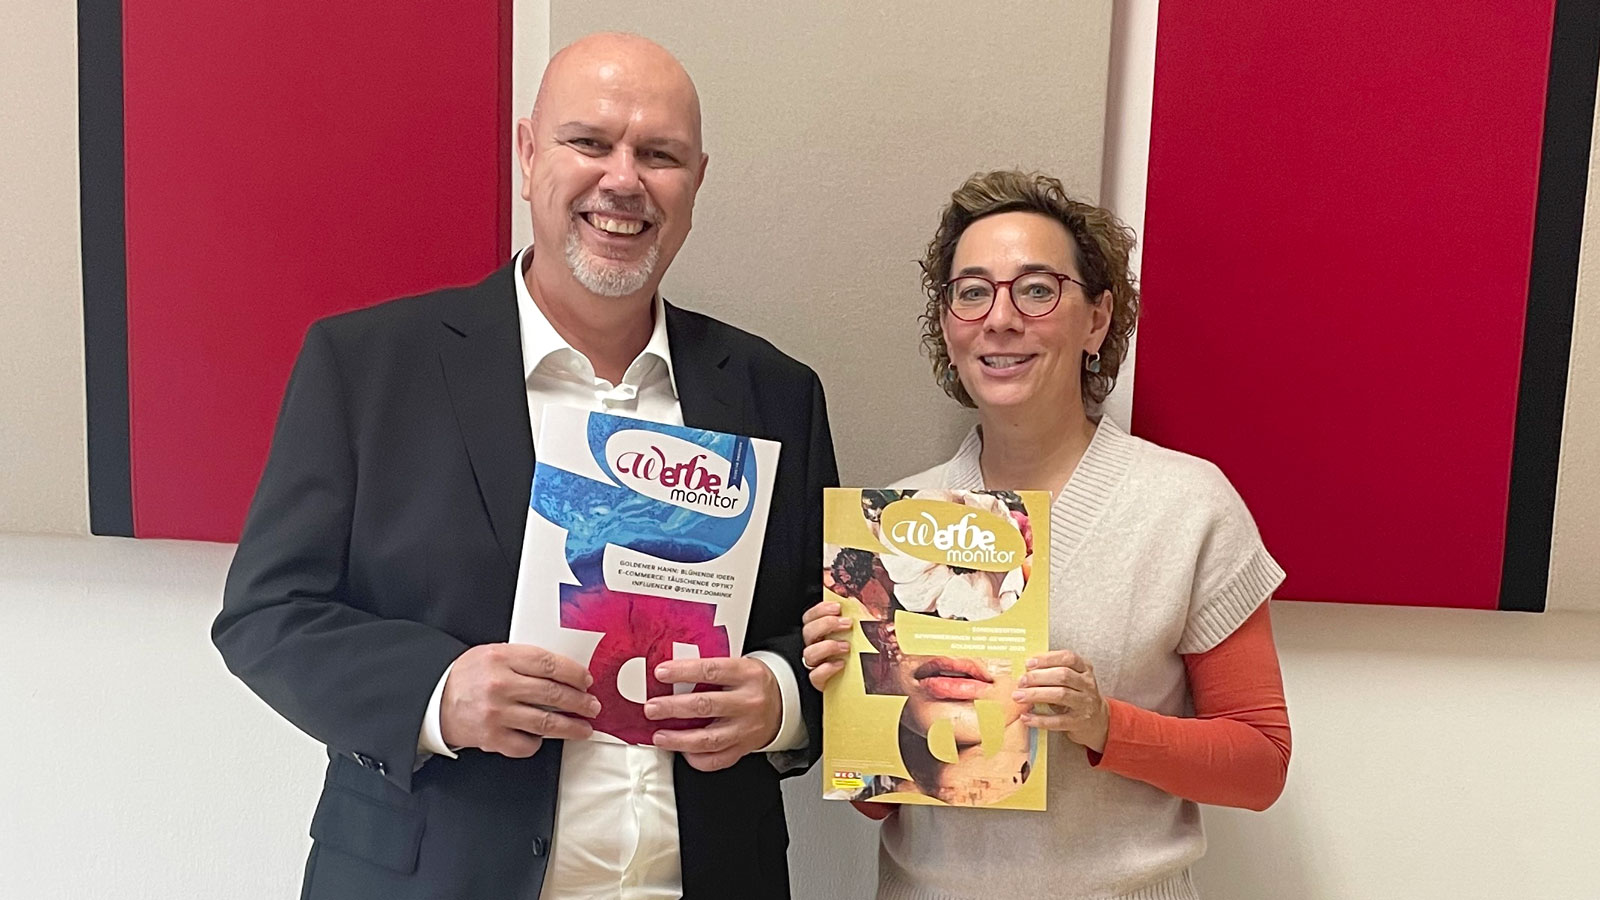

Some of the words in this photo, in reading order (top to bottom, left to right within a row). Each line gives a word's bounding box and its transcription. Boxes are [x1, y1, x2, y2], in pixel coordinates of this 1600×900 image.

[616, 445, 721, 494] Werbe
[670, 488, 738, 509] monitor
[891, 511, 995, 550] Werbe
[946, 548, 1015, 563] monitor
[618, 569, 666, 581] E-COMMERCE:
[667, 576, 709, 587] TÄUSCHENDE
[711, 582, 734, 590] OPTIK?
[619, 560, 656, 571] GOLDENER
[657, 566, 679, 574] HAHN:
[680, 569, 715, 579] BLÜHENDE
[631, 581, 672, 591] INFLUENCER
[674, 585, 733, 598] @SWEET.DOMINIK
